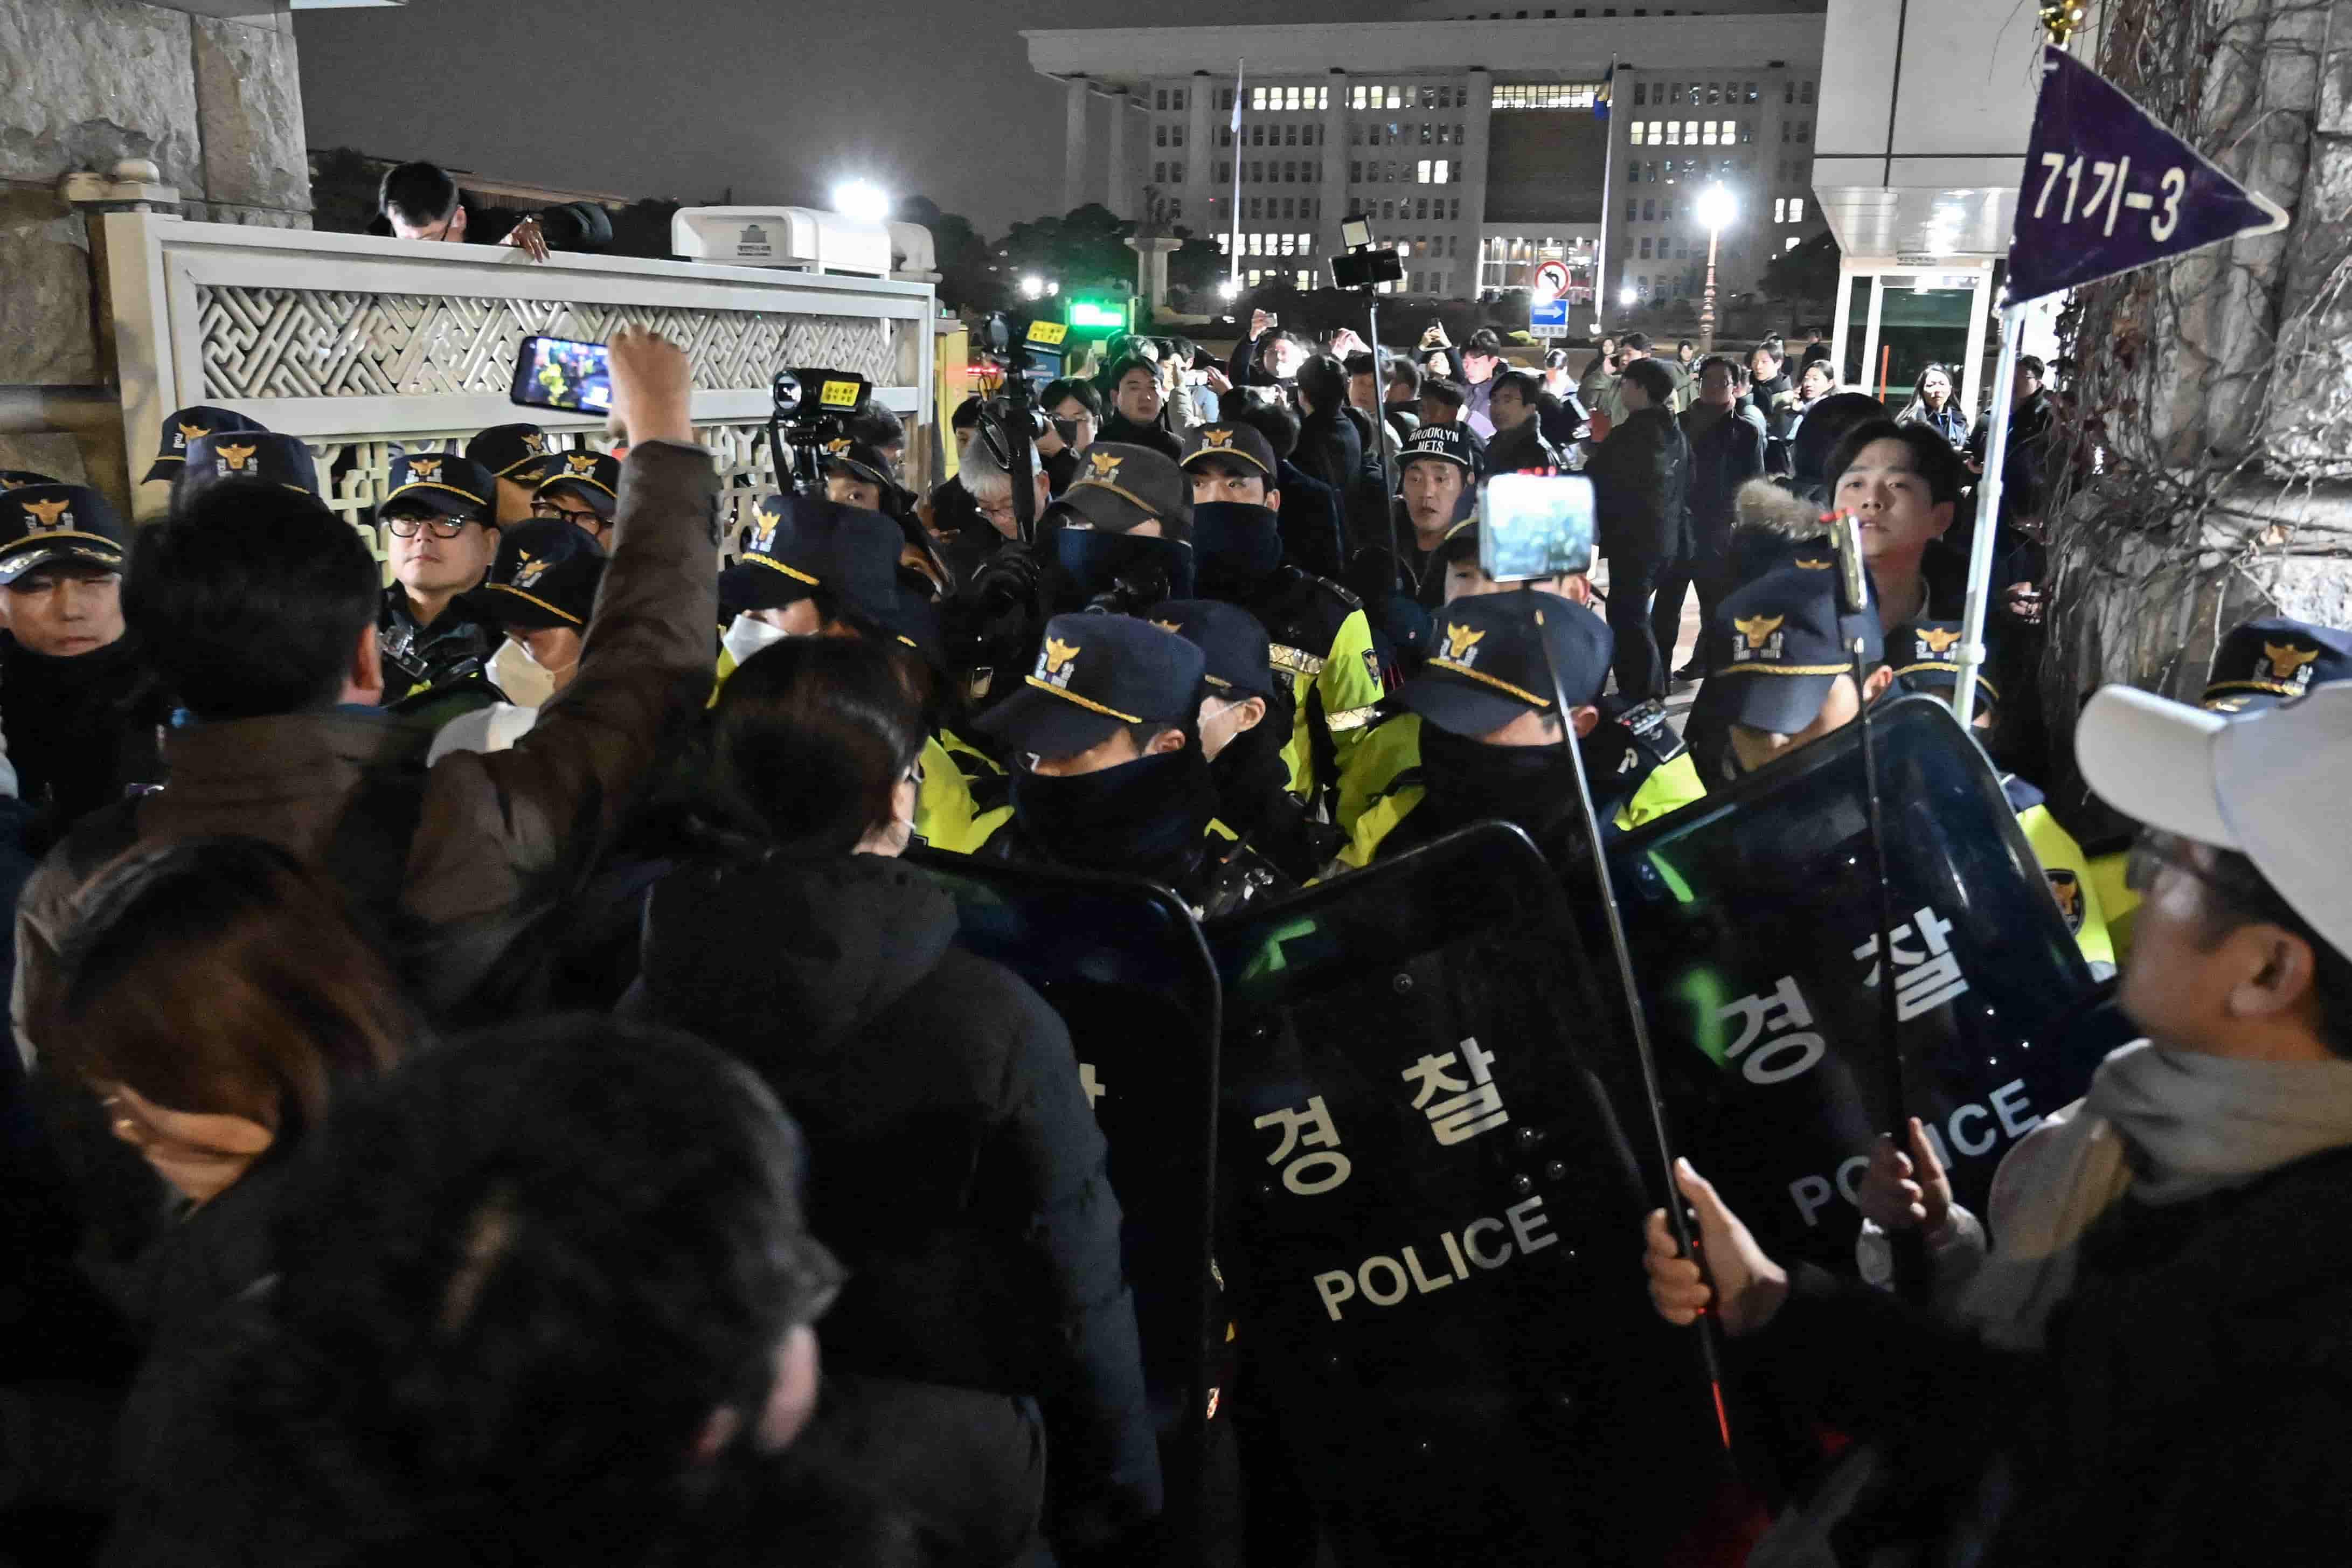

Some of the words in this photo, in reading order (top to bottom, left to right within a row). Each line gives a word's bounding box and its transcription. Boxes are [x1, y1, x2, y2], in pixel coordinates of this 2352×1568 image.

[2034, 152, 2186, 242] 71기-3
[1409, 427, 1459, 442] BROOKLYN
[1418, 440, 1445, 453] NETS
[1314, 1195, 1559, 1321] POLICE
